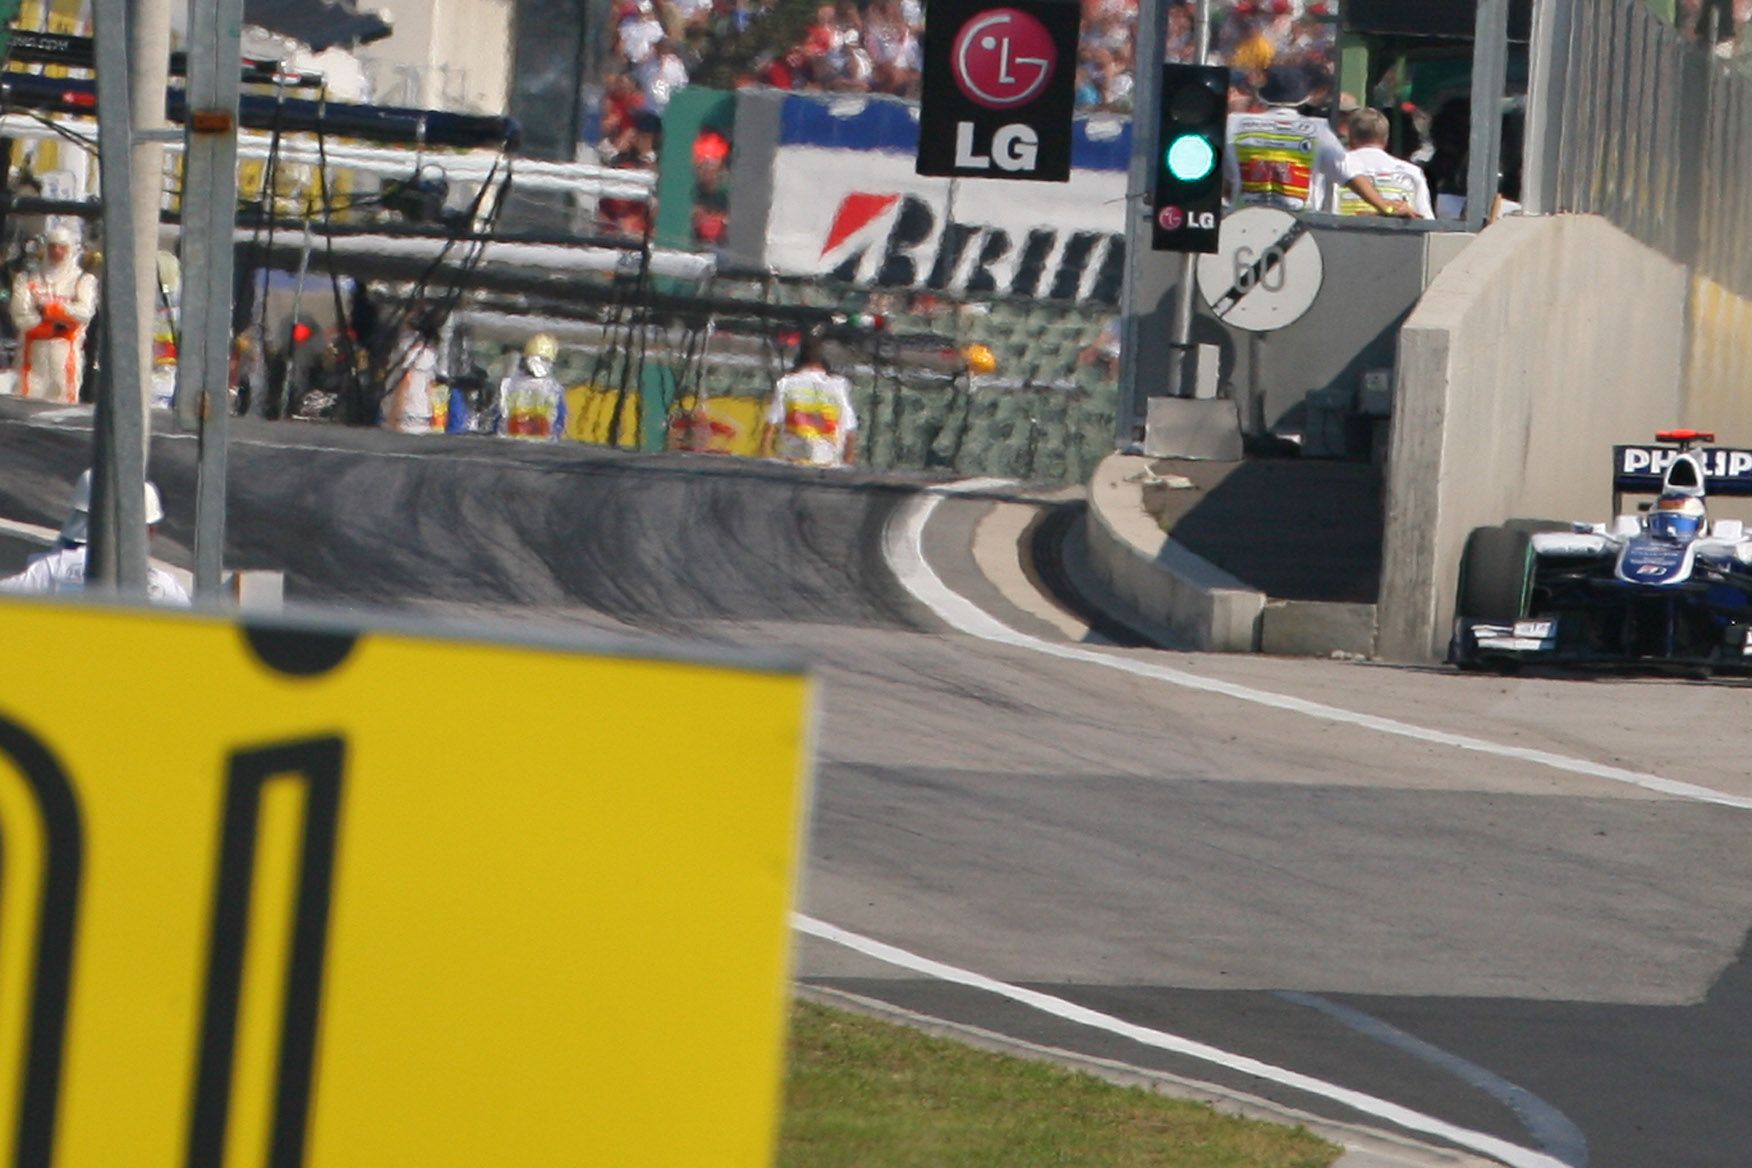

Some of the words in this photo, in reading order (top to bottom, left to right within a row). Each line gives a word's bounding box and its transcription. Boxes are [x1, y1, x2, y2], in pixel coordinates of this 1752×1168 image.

[955, 121, 1039, 172] LG
[1186, 211, 1215, 230] LG
[1234, 246, 1285, 294] 60
